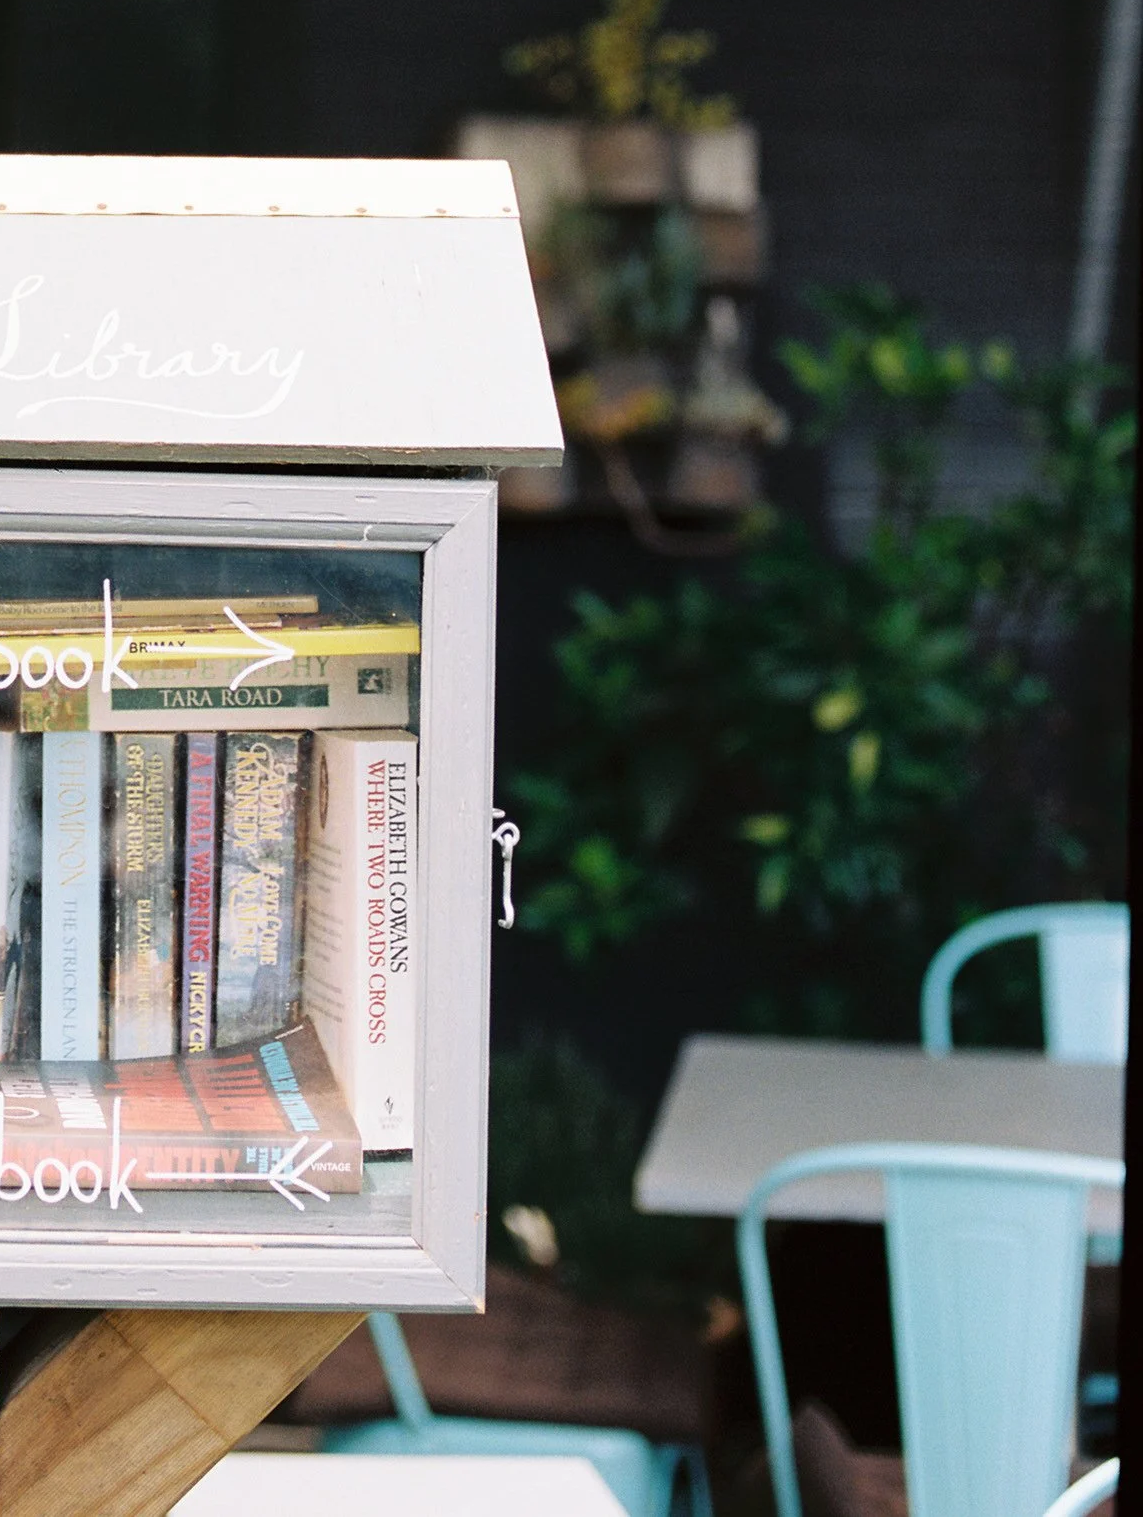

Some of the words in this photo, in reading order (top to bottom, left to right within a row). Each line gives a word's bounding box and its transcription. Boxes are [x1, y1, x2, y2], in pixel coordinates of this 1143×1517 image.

[159, 689, 213, 708] TARA
[221, 687, 283, 706] ROAD
[126, 744, 145, 771] OF
[190, 748, 212, 770] A
[126, 771, 145, 810] THE
[145, 752, 165, 864] DAUGHTERS
[189, 775, 213, 847] FINAL
[233, 750, 268, 867] KENNEDY
[366, 758, 386, 833] WHERE
[388, 761, 407, 876] ELIZABETH
[126, 811, 145, 873] STORM
[366, 839, 386, 890] TWO
[62, 899, 77, 931] THE
[187, 850, 212, 962] WARNING
[260, 866, 284, 915] LOVE
[259, 915, 282, 966] COME
[367, 898, 386, 968] ROADS
[388, 881, 408, 973] GOWANS
[61, 936, 77, 1022] STRICKEN
[188, 971, 208, 1028] NICKY
[368, 973, 387, 1044] CROSS
[61, 1024, 77, 1061] LAN
[188, 1030, 206, 1054] CR
[311, 1161, 351, 1173] VINTAGE
